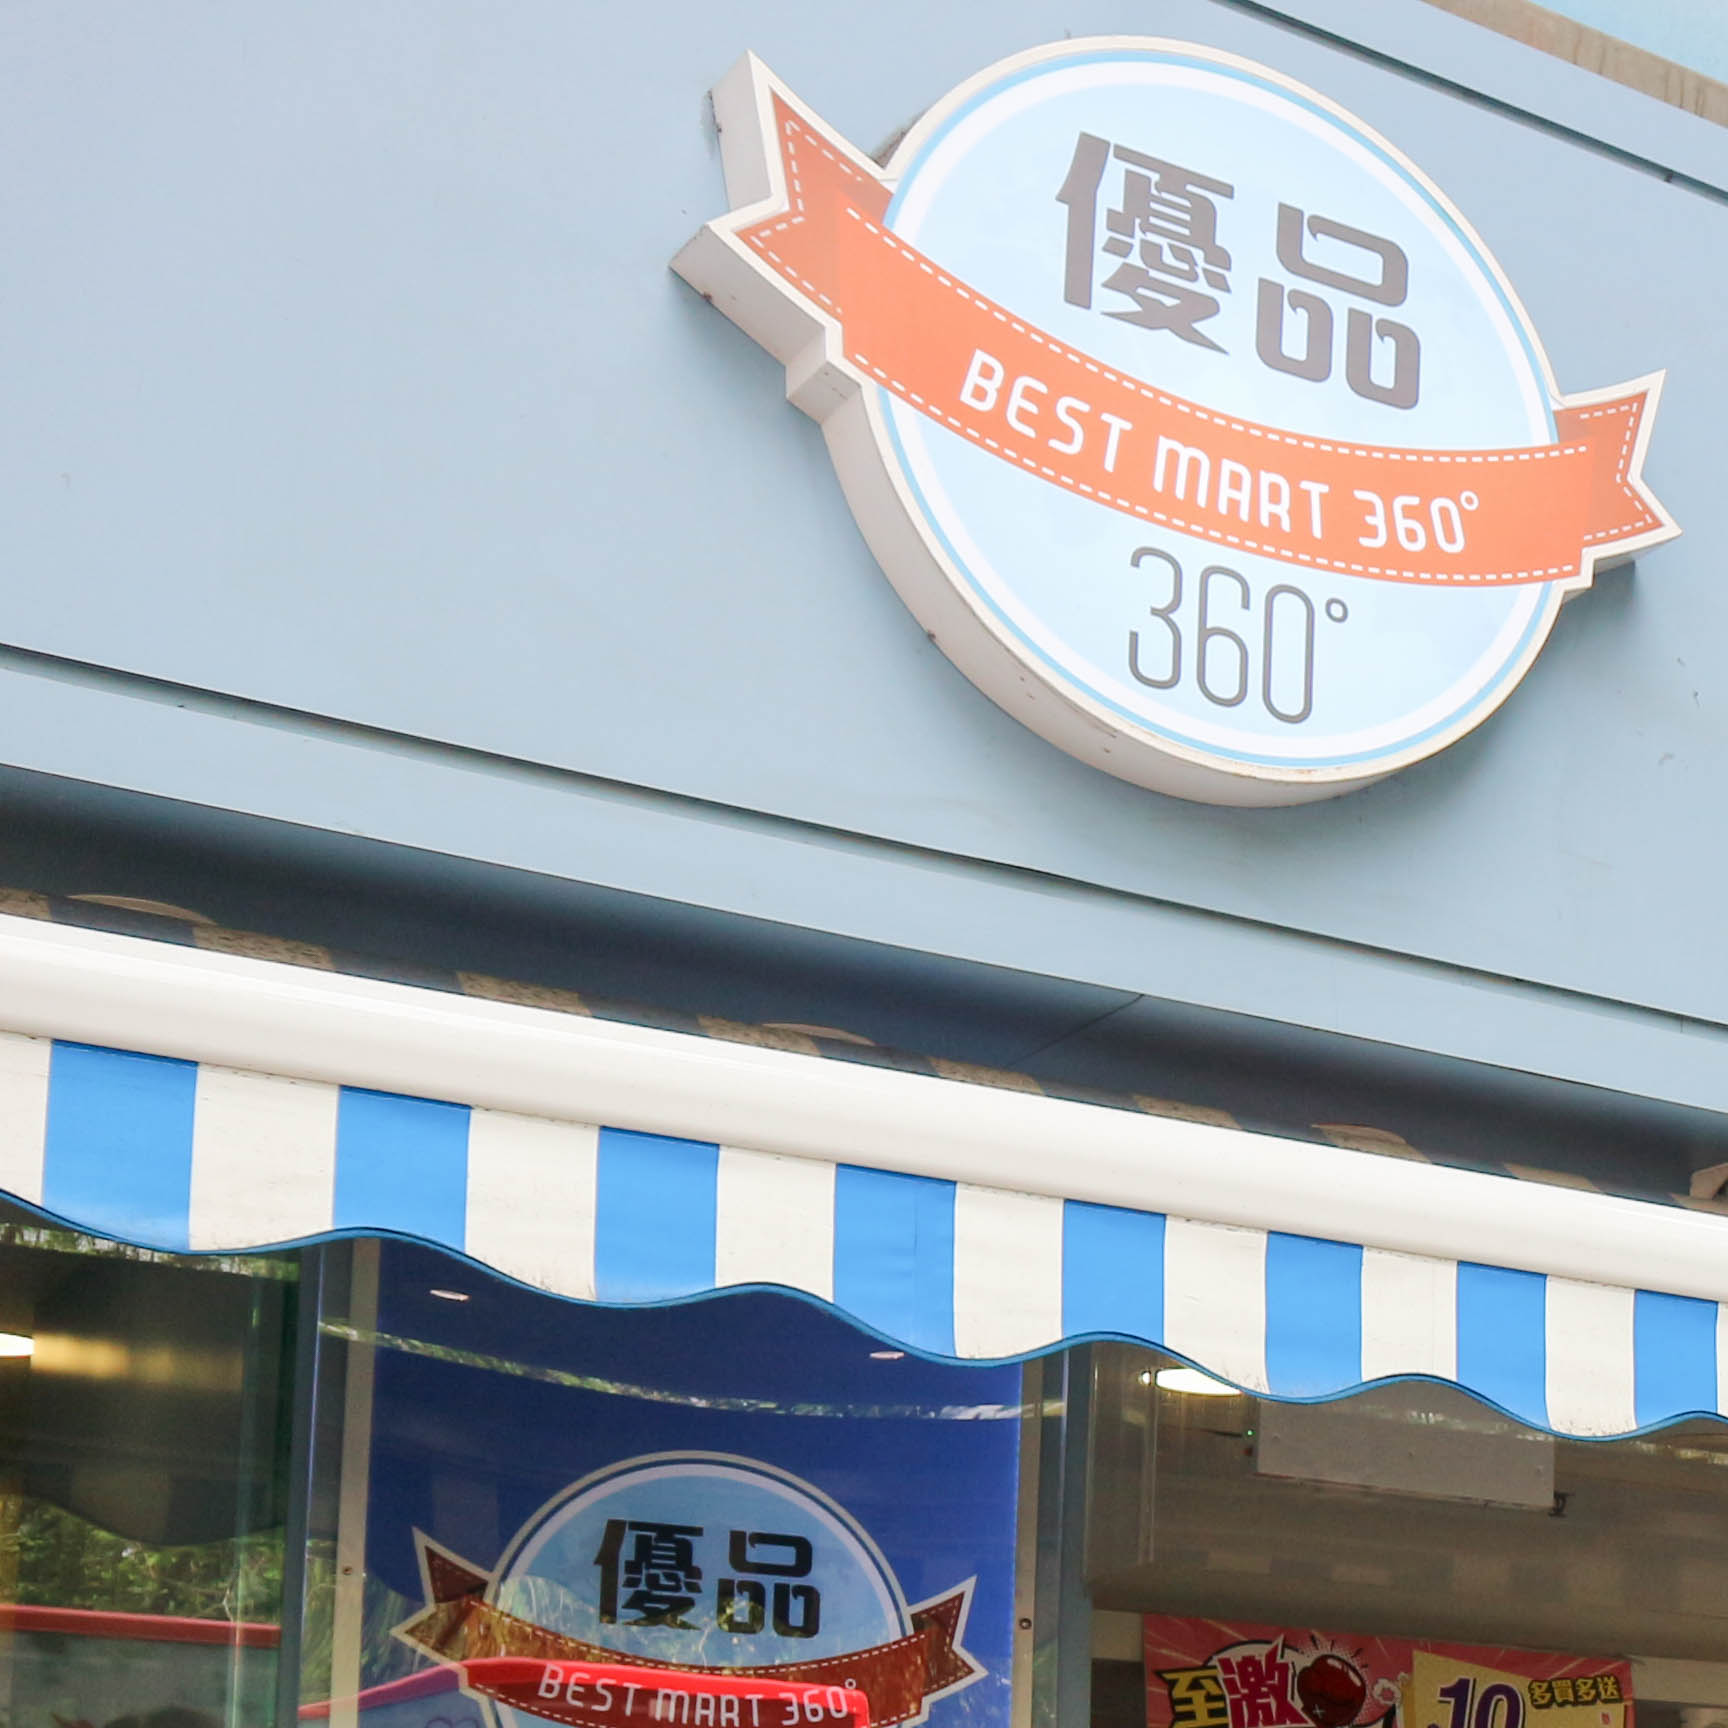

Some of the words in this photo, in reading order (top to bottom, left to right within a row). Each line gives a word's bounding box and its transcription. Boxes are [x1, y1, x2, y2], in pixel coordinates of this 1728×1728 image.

[1056, 131, 1421, 411] 優品
[961, 348, 1132, 475] BEST
[1153, 433, 1328, 541] MART
[594, 1518, 822, 1639] 優品
[537, 1663, 638, 1716] BEST
[653, 1686, 764, 1727] MART
[1528, 1676, 1624, 1709] 多買多送
